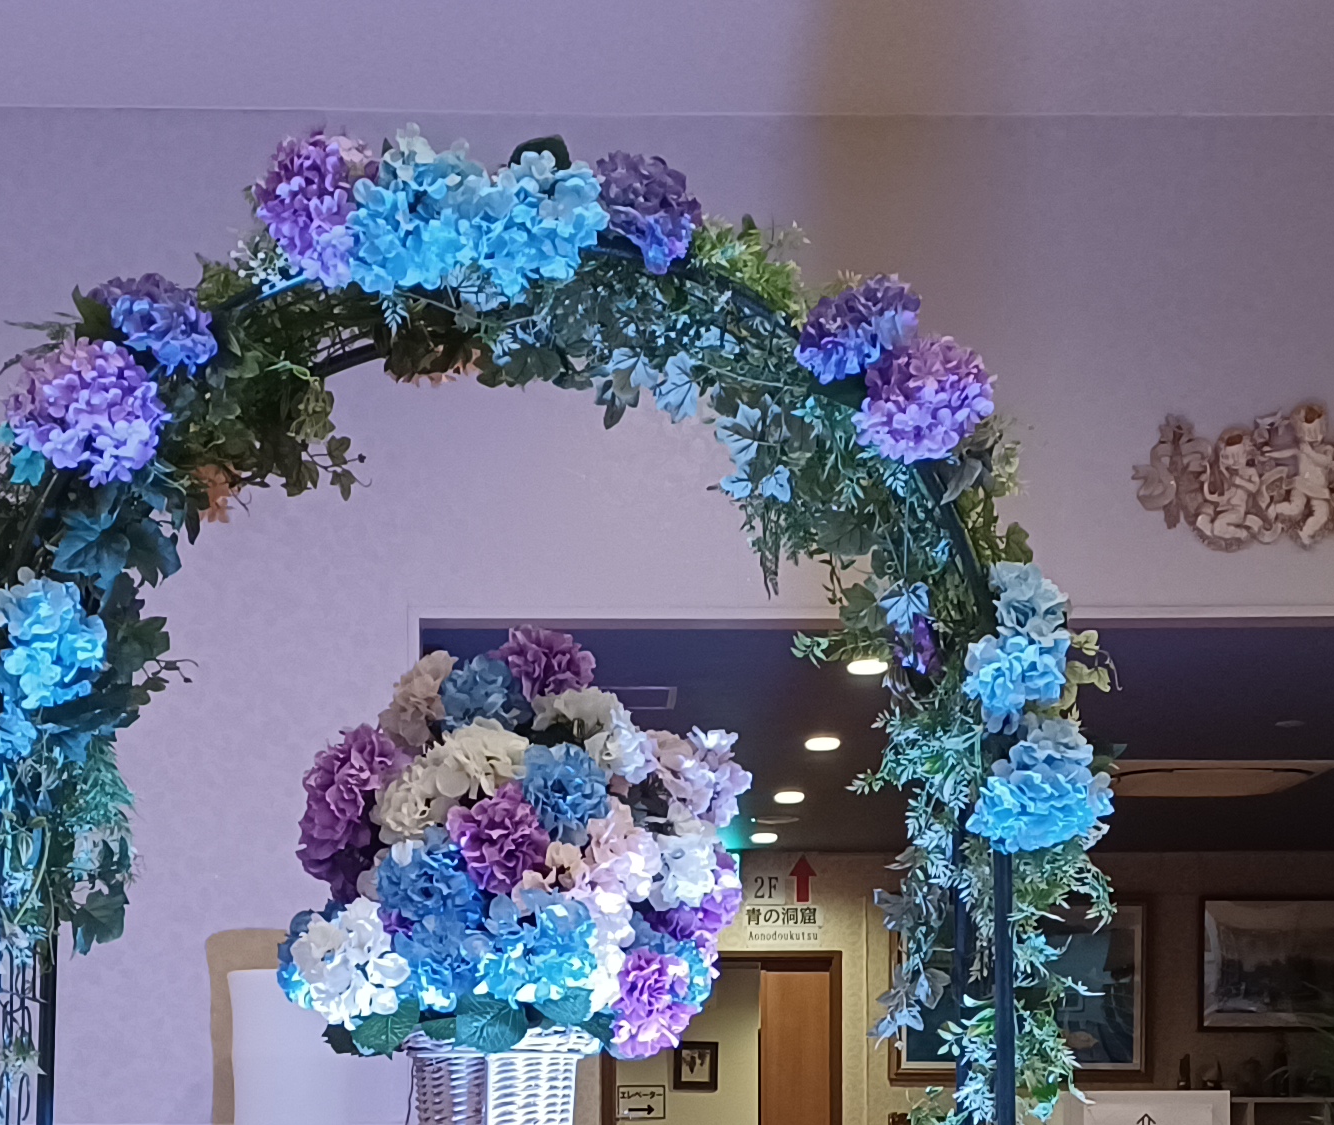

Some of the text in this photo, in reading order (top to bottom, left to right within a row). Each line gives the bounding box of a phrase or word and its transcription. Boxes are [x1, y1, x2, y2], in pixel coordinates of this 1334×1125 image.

[754, 876, 779, 899] 2F
[746, 907, 817, 925] 青の洞窟
[748, 930, 818, 941] Aonodoukutsu
[620, 1091, 663, 1100] エレベーター
